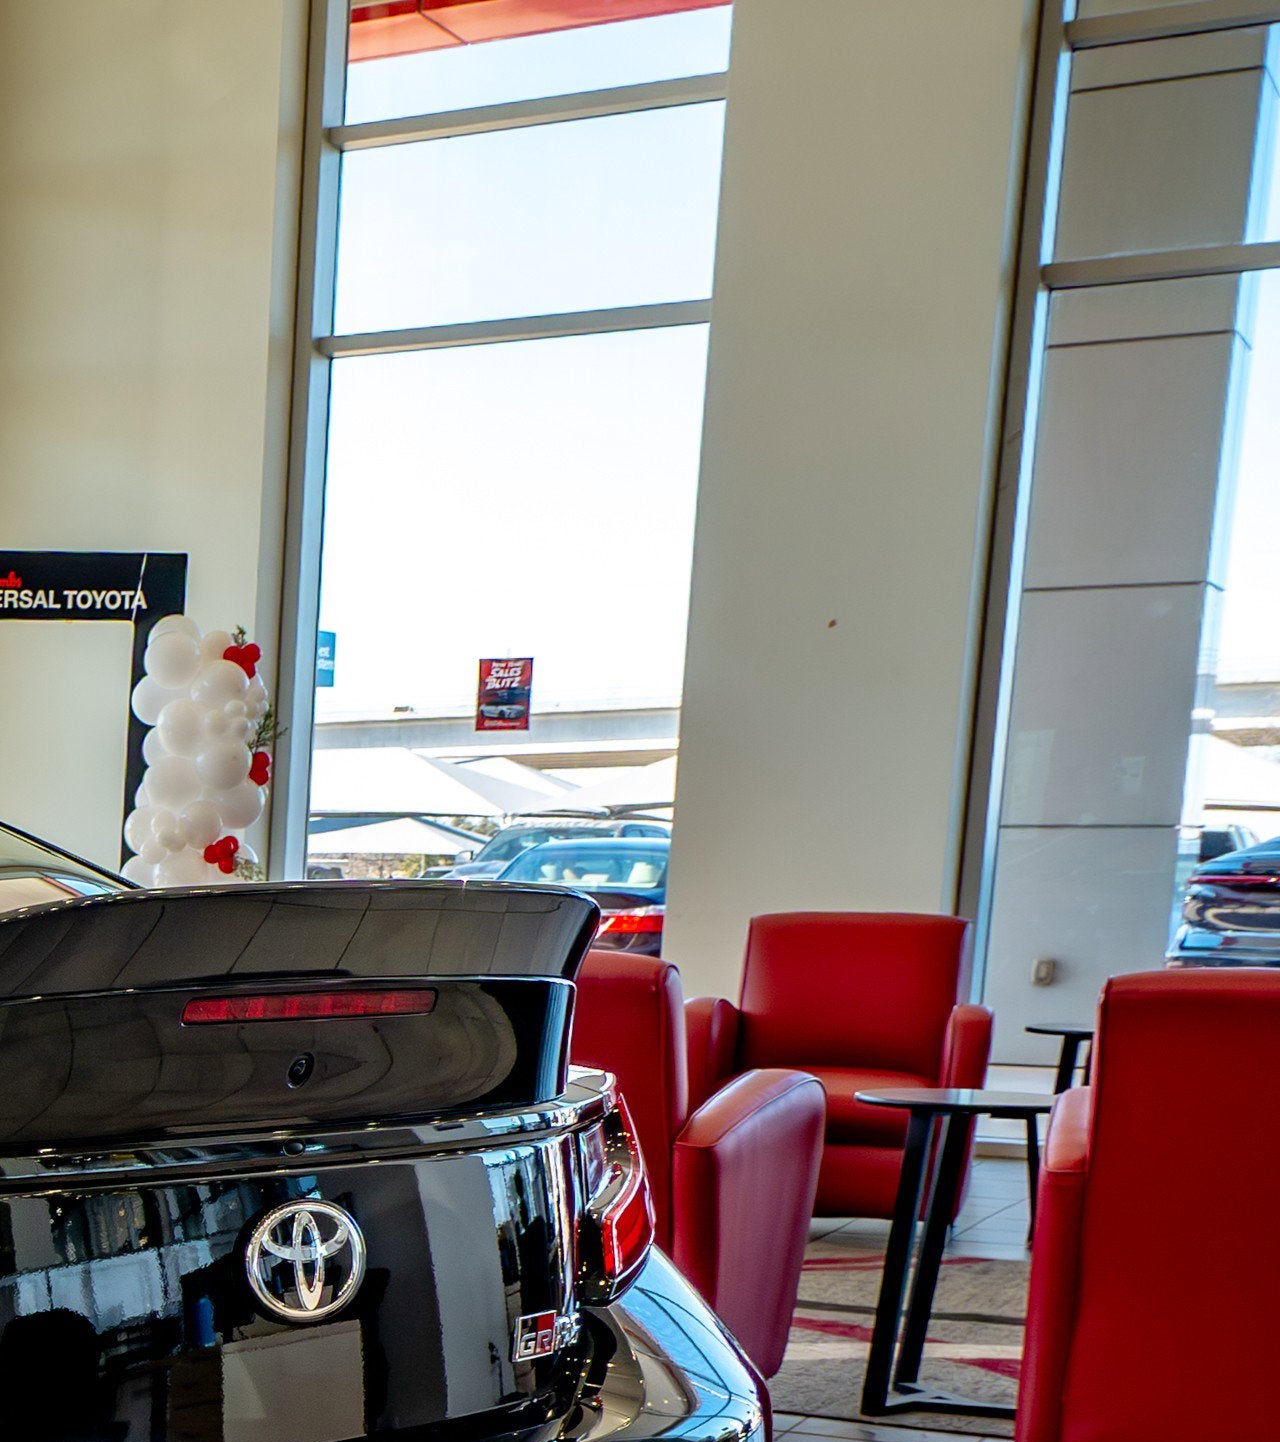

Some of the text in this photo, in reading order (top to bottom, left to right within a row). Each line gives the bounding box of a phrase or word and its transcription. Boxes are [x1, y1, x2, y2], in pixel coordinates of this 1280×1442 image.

[63, 589, 148, 610] TOYOTA
[490, 667, 522, 678] SALES
[485, 677, 522, 690] BLITZ
